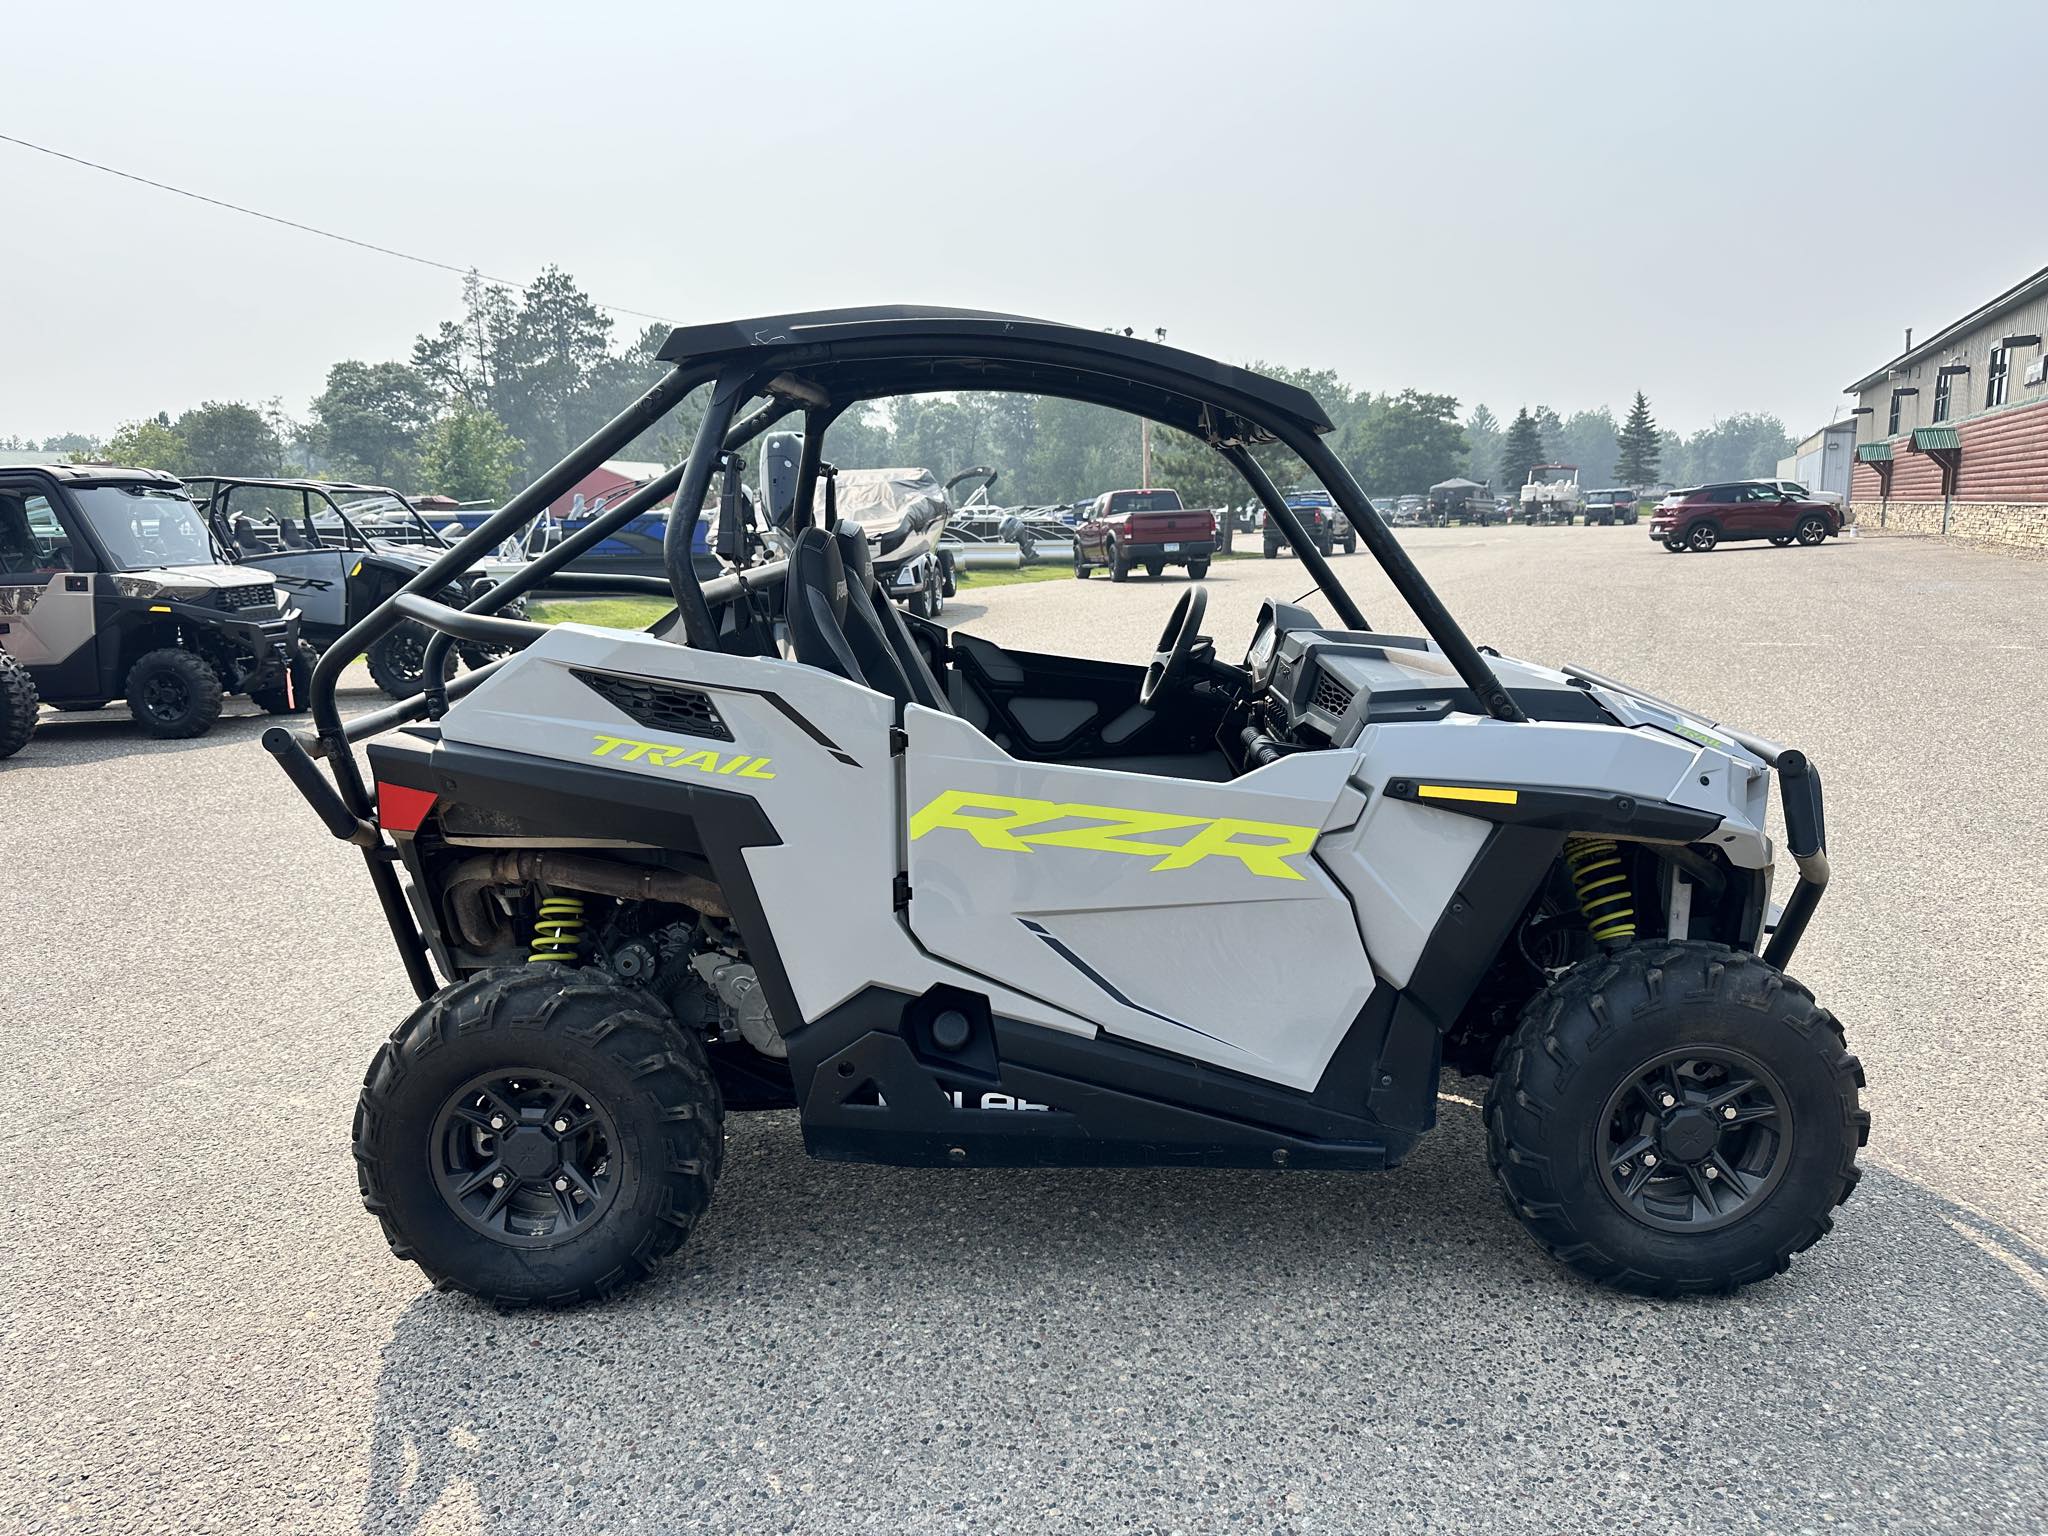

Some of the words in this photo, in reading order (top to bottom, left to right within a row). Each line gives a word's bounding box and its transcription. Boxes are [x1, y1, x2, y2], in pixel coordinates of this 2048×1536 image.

[275, 575, 334, 592] ZR
[592, 735, 776, 780] TRAIL
[910, 790, 1319, 881] RZR
